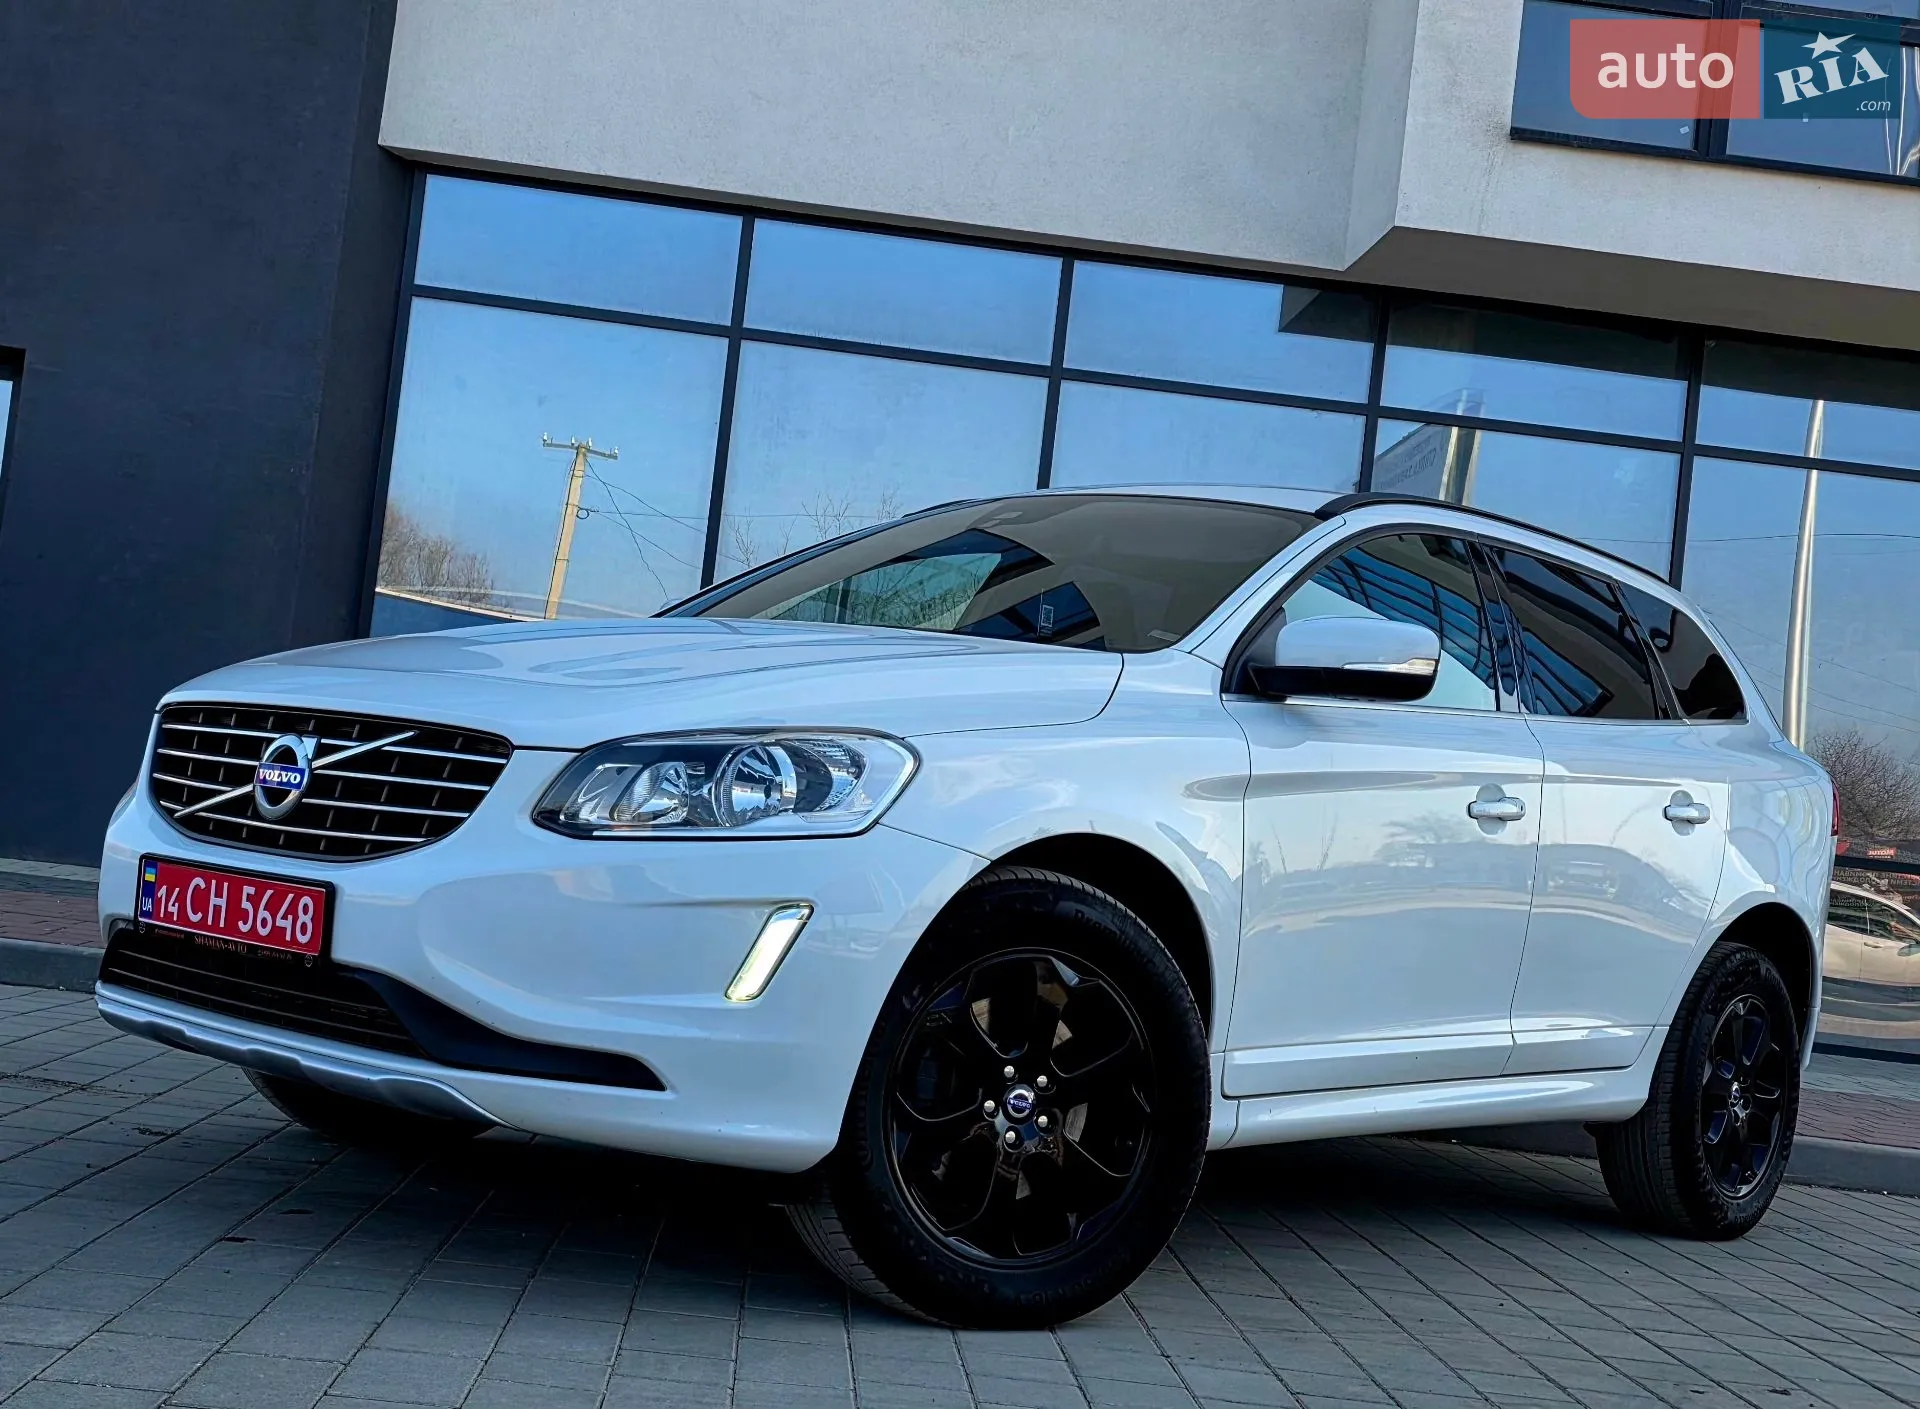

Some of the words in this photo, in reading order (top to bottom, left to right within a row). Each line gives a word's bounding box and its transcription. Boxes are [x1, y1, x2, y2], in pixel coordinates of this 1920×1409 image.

[259, 768, 301, 784] VOLVO
[142, 897, 153, 912] UA
[157, 885, 180, 921] 14
[186, 876, 229, 928] CH
[238, 885, 314, 944] 5648
